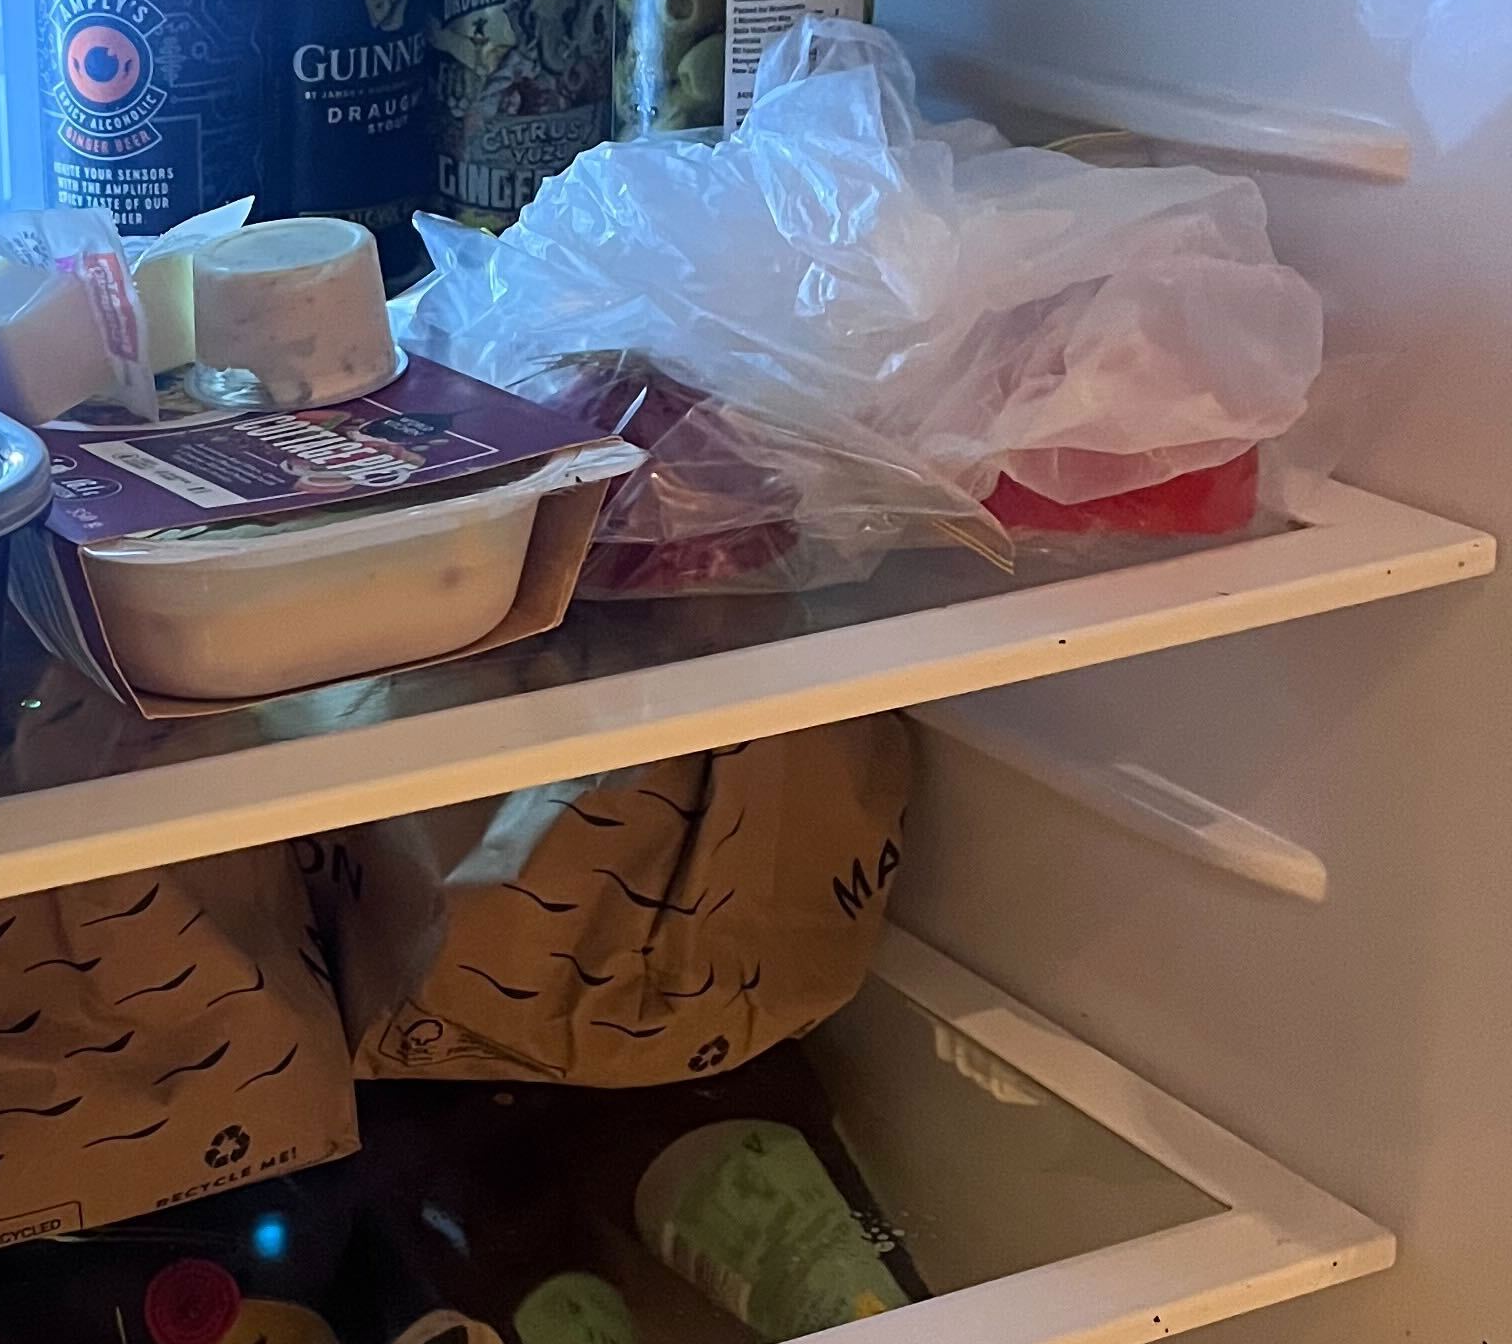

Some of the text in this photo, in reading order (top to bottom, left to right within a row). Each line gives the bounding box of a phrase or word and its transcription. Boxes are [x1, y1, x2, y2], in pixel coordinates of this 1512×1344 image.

[292, 31, 426, 84] GUINNE
[57, 90, 157, 131] SPICY ALCOHOLIC
[65, 125, 152, 154] GINGER BEER
[481, 119, 581, 154] CITRUS
[511, 141, 570, 165] YUZU
[57, 176, 170, 196] WITH THE AMPLIFIED
[83, 167, 114, 182] YOUR
[117, 167, 175, 182] SENSORS
[439, 157, 548, 209] GINGE
[85, 195, 121, 211] TASTE
[124, 197, 140, 211] OF
[144, 195, 170, 209] OUR
[233, 414, 378, 465] COTTAGE
[155, 1145, 298, 1209] RECYCLE ME!
